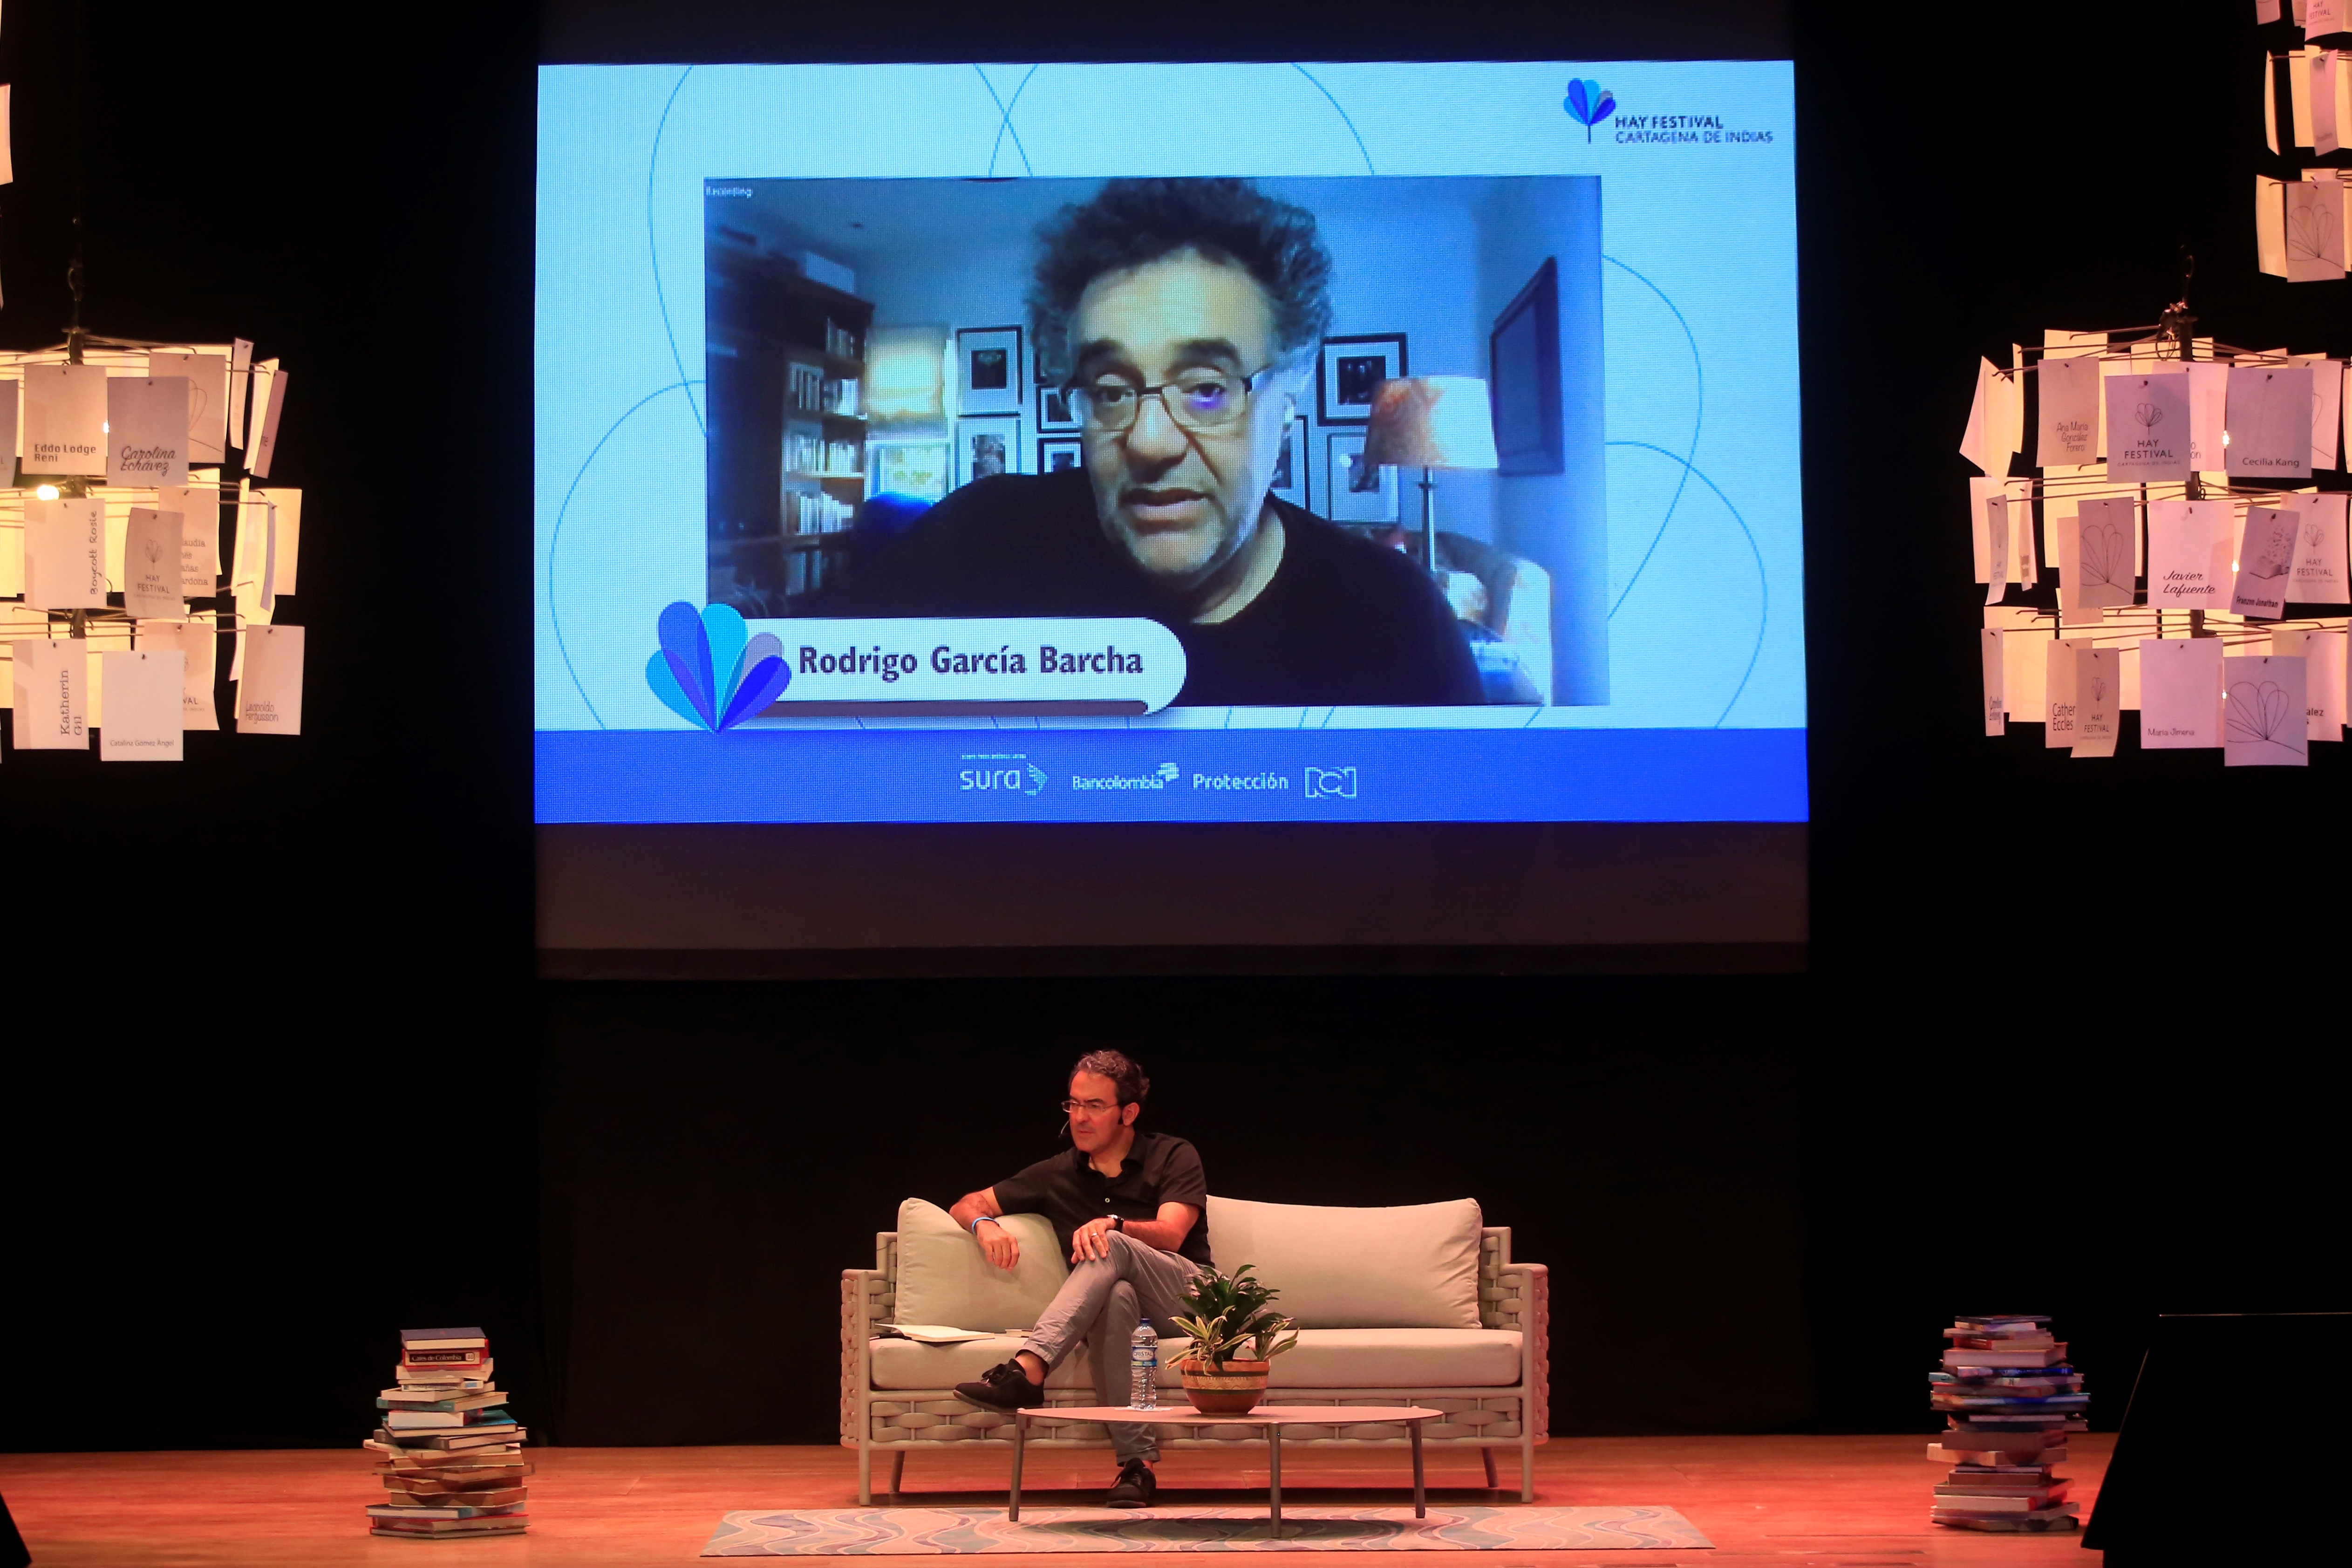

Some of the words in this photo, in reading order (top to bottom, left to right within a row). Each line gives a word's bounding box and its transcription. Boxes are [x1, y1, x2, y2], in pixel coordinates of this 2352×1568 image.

[1615, 115, 1648, 129] HAY
[1653, 115, 1724, 129] FESTIVAL
[1616, 131, 1698, 143] CARTAGENA
[1704, 131, 1721, 143] DE
[1725, 130, 1773, 143] INDIAS
[2056, 422, 2069, 432] Ana
[35, 443, 61, 453] Eddo
[64, 444, 96, 456] Lodge
[2066, 443, 2085, 452] Forero
[2137, 439, 2159, 447] HAY
[34, 453, 58, 462] Reni
[122, 446, 176, 460] Carolina
[2124, 450, 2173, 459] FESTIVAL
[2243, 457, 2272, 466] Cecilia
[2276, 458, 2299, 468] Kang
[89, 511, 98, 544] Rosie
[89, 549, 102, 595] Boycott
[146, 574, 160, 583] HAY
[2163, 570, 2203, 580] Javier
[2297, 568, 2332, 576] FESTIVAL
[137, 583, 170, 594] FESTIVAL
[2163, 583, 2216, 598] Lafuente
[799, 646, 917, 682] Rodrigo
[931, 645, 1026, 675] García
[1040, 646, 1143, 674] Barcha
[60, 669, 70, 736] Katherin
[246, 701, 274, 712] Leopoldo
[74, 716, 82, 736] Gil
[2052, 716, 2073, 731] Eccles
[2084, 724, 2109, 733] FESTIVAL
[960, 770, 1020, 790] sura
[1072, 774, 1164, 790] Bancolombia
[1193, 772, 1289, 790] Protección
